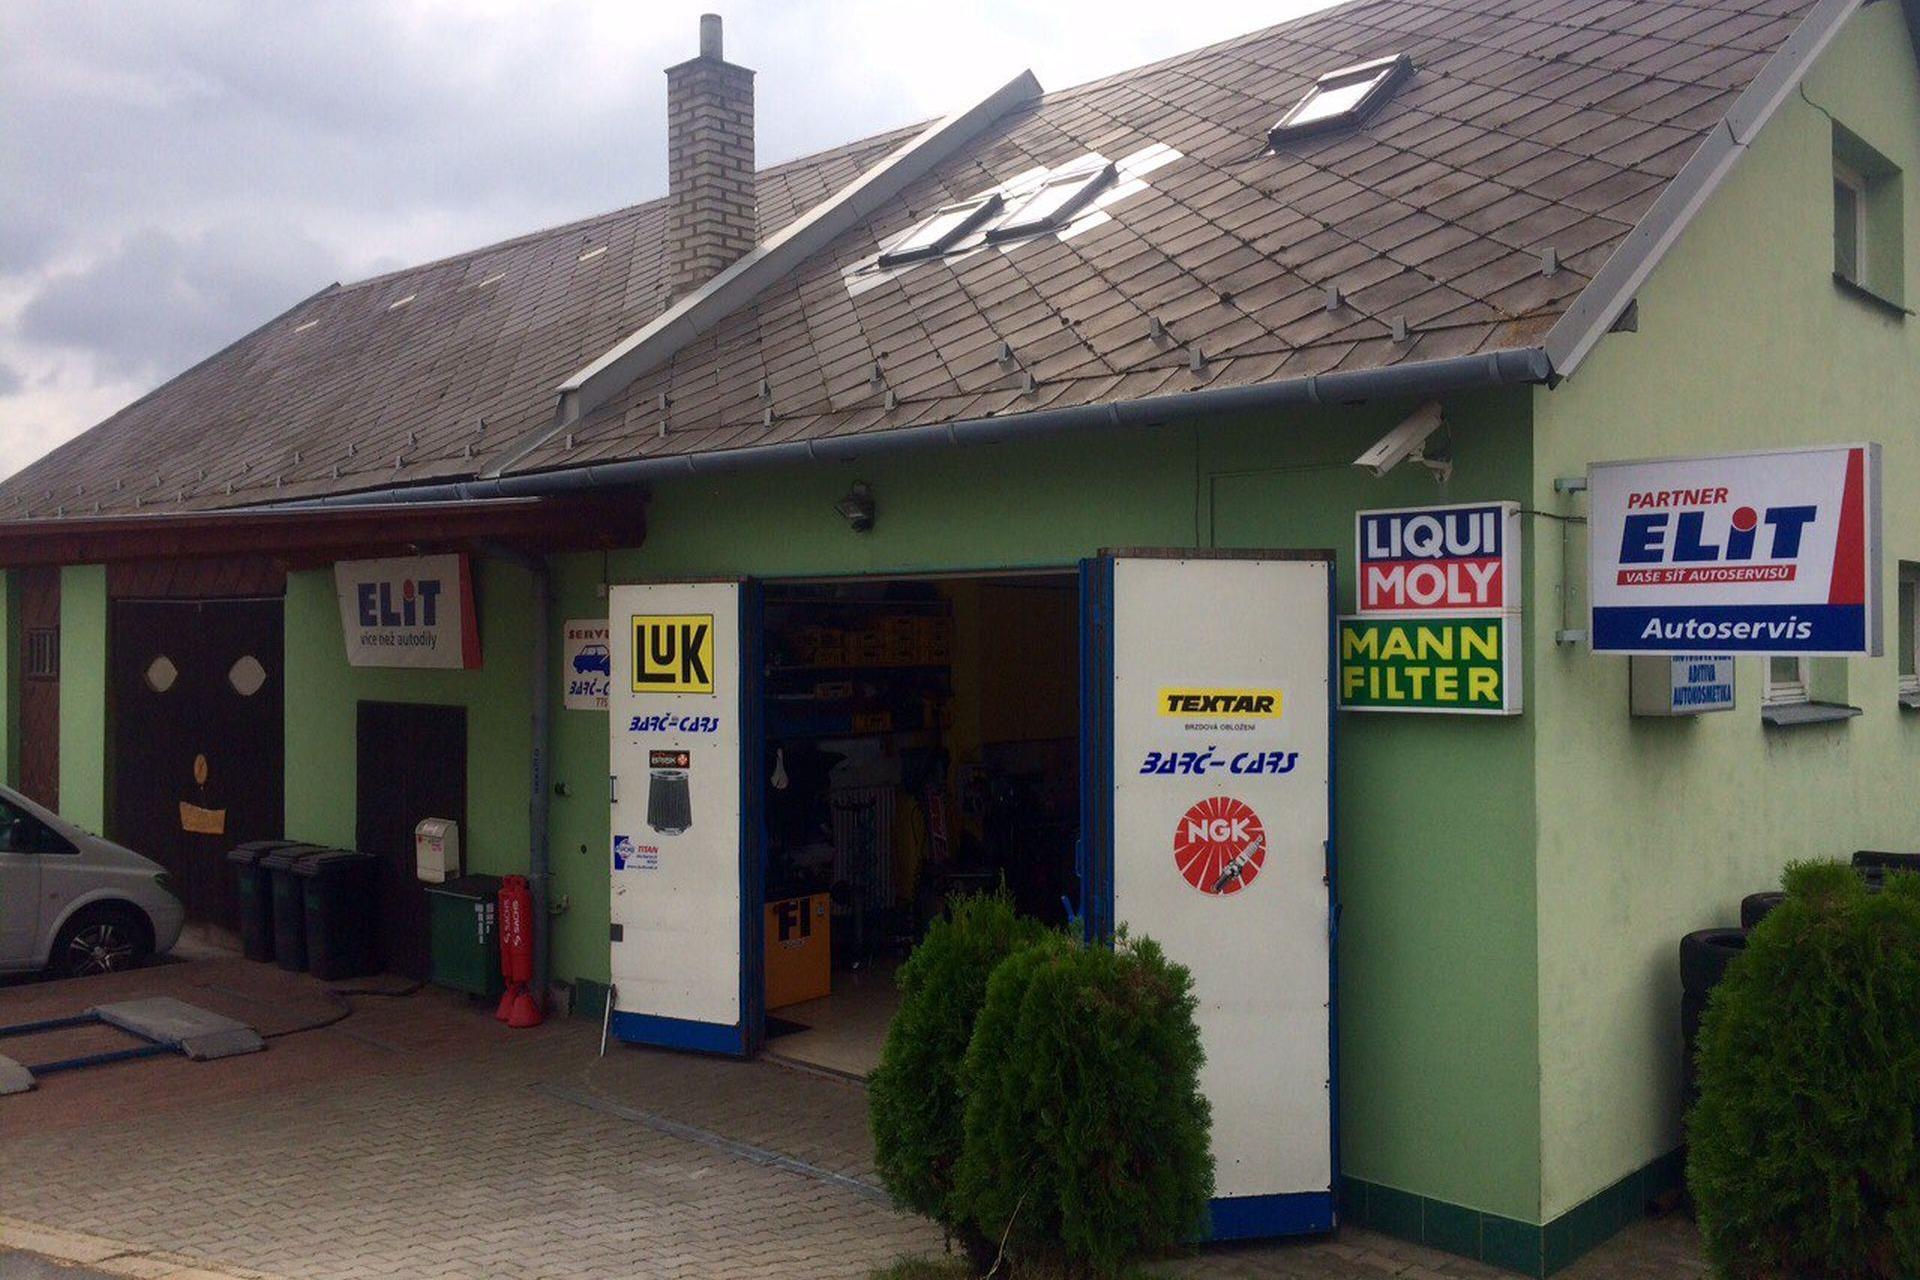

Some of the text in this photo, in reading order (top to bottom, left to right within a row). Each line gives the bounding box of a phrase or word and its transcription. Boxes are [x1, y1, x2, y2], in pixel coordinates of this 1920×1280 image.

[1628, 487, 1729, 509] PARTNER
[1367, 512, 1495, 558] LIQUI
[1368, 562, 1500, 605] MOLY
[1641, 616, 1812, 640] Autoservis
[1343, 626, 1498, 660] MANN
[1343, 666, 1499, 701] FILTER
[1167, 695, 1275, 713] TEXTAR
[1188, 817, 1250, 844] NGK
[638, 845, 659, 854] TITAN
